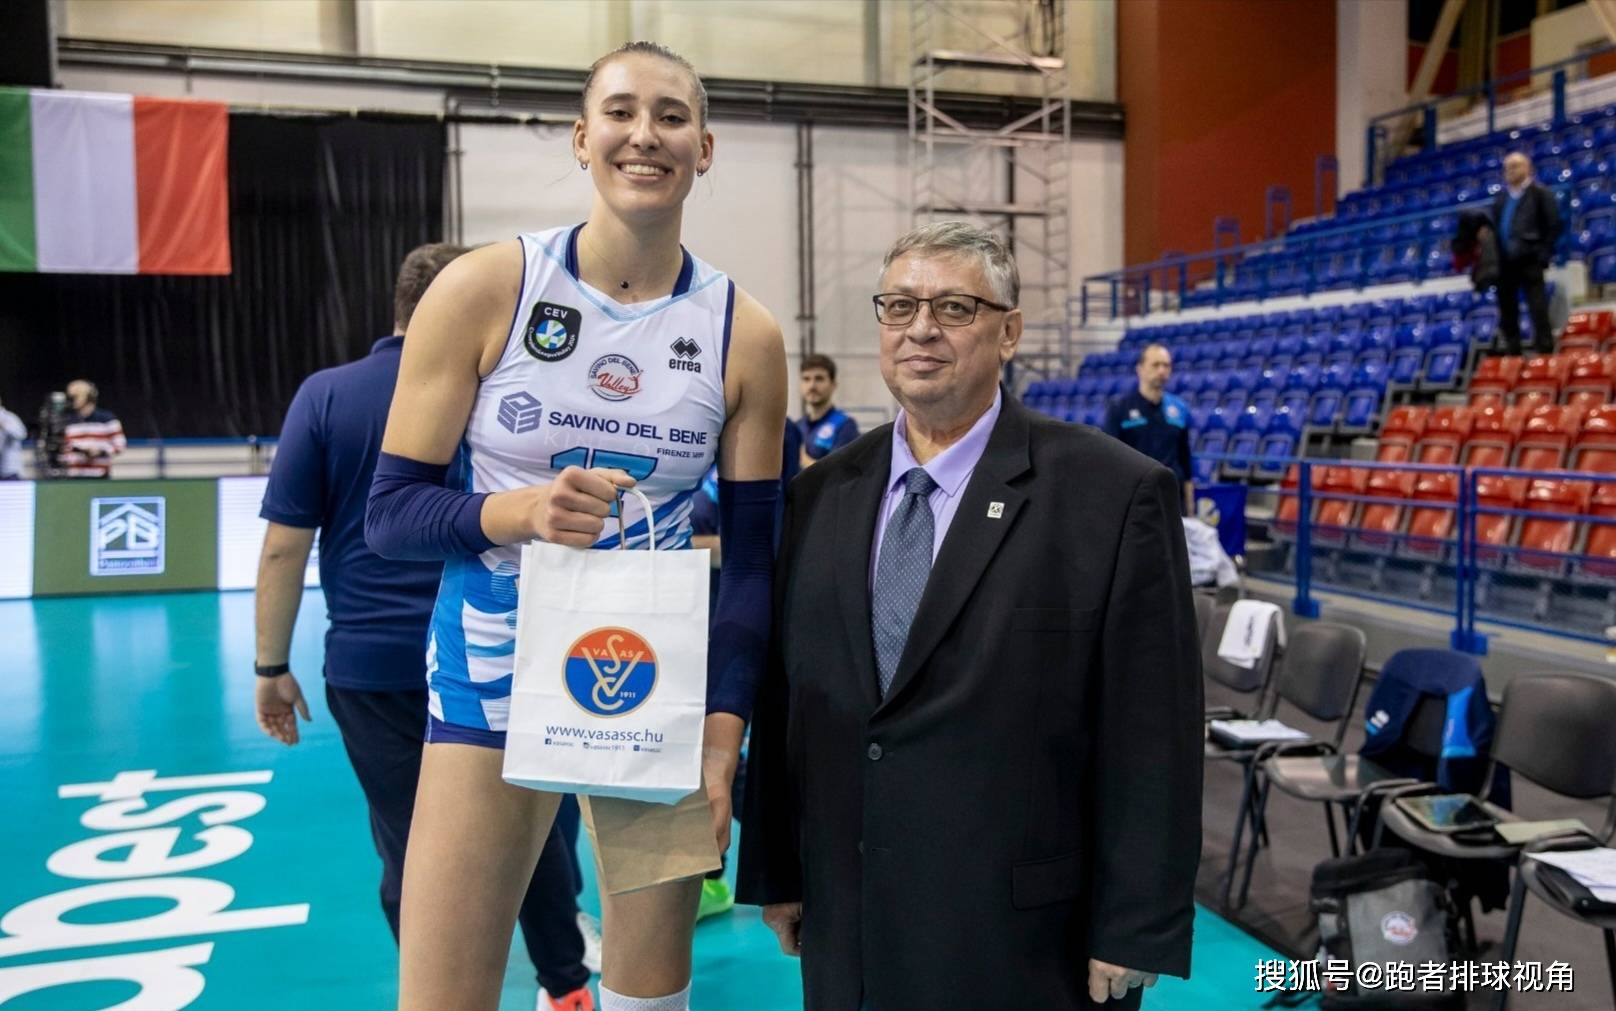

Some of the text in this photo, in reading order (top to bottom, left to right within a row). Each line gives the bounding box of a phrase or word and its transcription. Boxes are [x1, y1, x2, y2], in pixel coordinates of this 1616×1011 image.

[544, 307, 568, 319] CEV
[590, 359, 607, 379] SAVINO
[548, 411, 620, 434] SAVINO
[626, 422, 663, 440] DEL
[669, 428, 707, 445] BENE
[657, 448, 691, 458] FIRENZE
[619, 691, 637, 699] 1911
[546, 725, 664, 743] www.vasassc.hu
